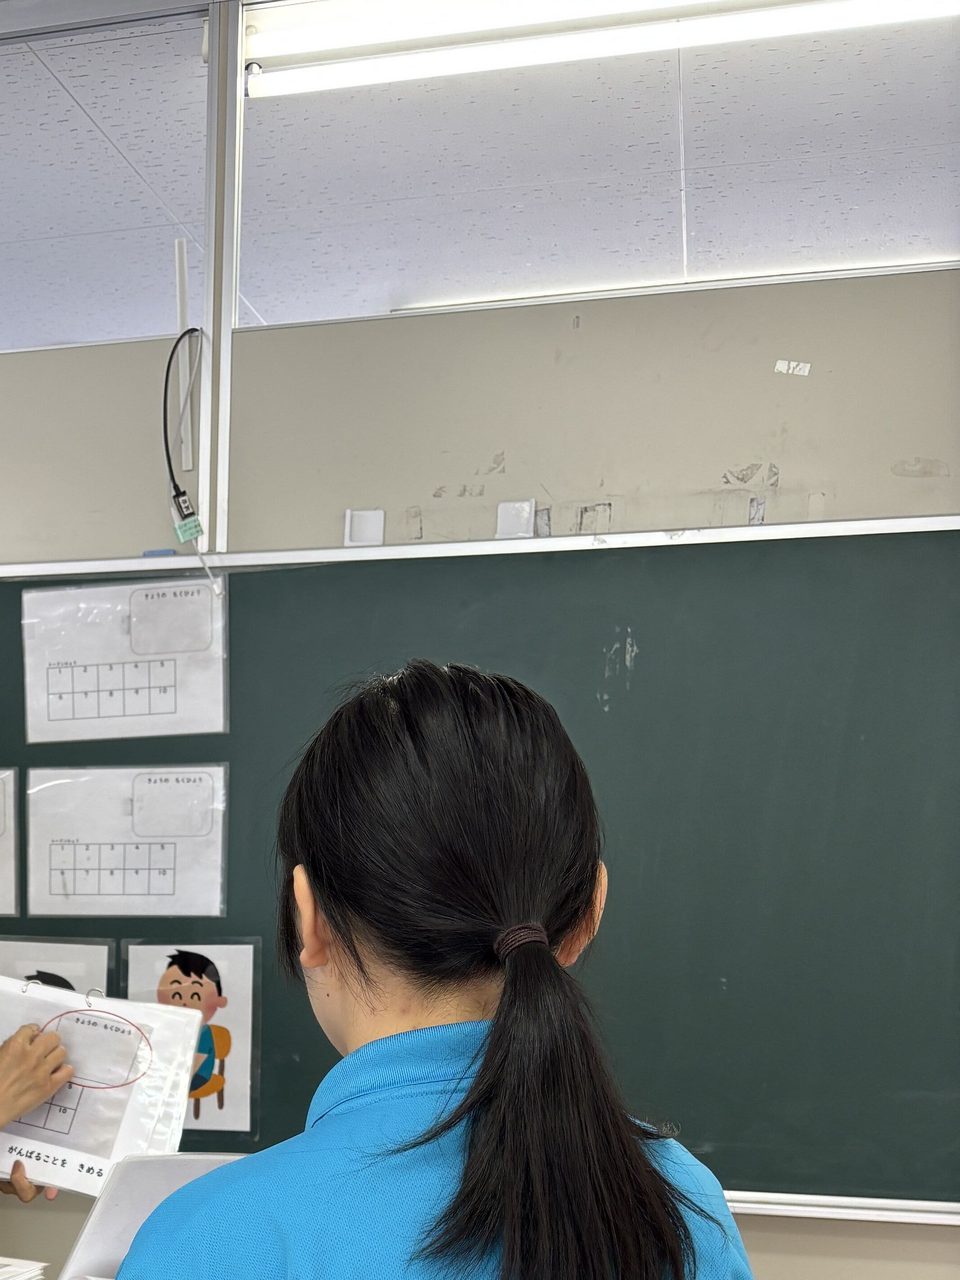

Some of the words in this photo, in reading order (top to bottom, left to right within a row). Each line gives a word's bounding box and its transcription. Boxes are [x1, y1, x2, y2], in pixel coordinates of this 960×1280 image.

[74, 1017, 98, 1028] きょうの
[103, 1023, 132, 1036] もくひょう
[7, 1146, 68, 1168] がんばることを
[77, 1163, 104, 1178] きめる
